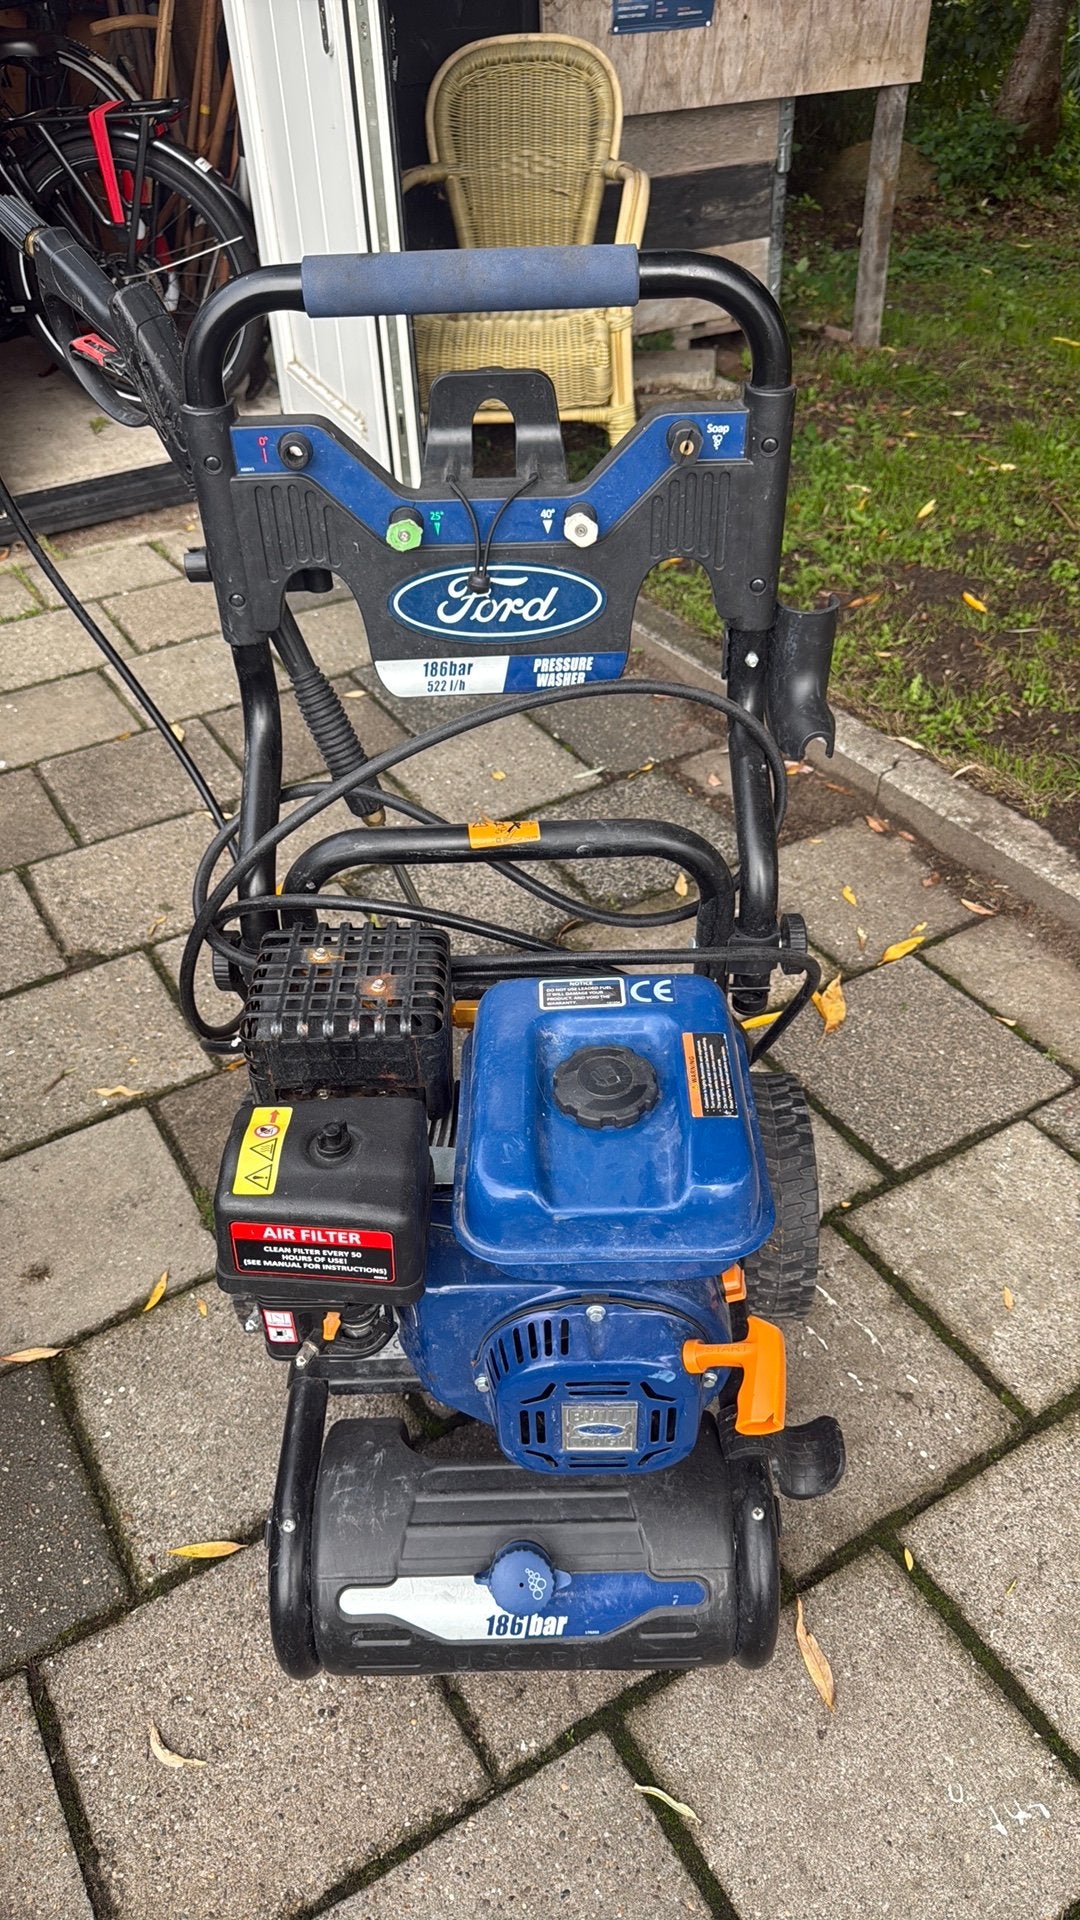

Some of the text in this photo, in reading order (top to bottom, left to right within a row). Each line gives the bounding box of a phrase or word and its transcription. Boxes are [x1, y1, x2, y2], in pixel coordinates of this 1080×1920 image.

[707, 423, 730, 435] Soap
[430, 511, 444, 521] 25°
[540, 508, 555, 519] 40°
[436, 576, 559, 623] Ford
[423, 661, 473, 677] 186bar
[533, 656, 594, 673] PRESSURE
[427, 680, 447, 692] 522
[536, 672, 586, 687] WASHER
[689, 1055, 697, 1082] WARNING
[263, 1226, 361, 1244] AIR FILTER
[281, 1254, 312, 1262] HOURS
[322, 1249, 349, 1257] EVERY
[243, 1258, 261, 1266] (SEE
[263, 1260, 302, 1268] MANUAL
[322, 1264, 387, 1275] INSTRUCTIONS)
[705, 1344, 747, 1352] START
